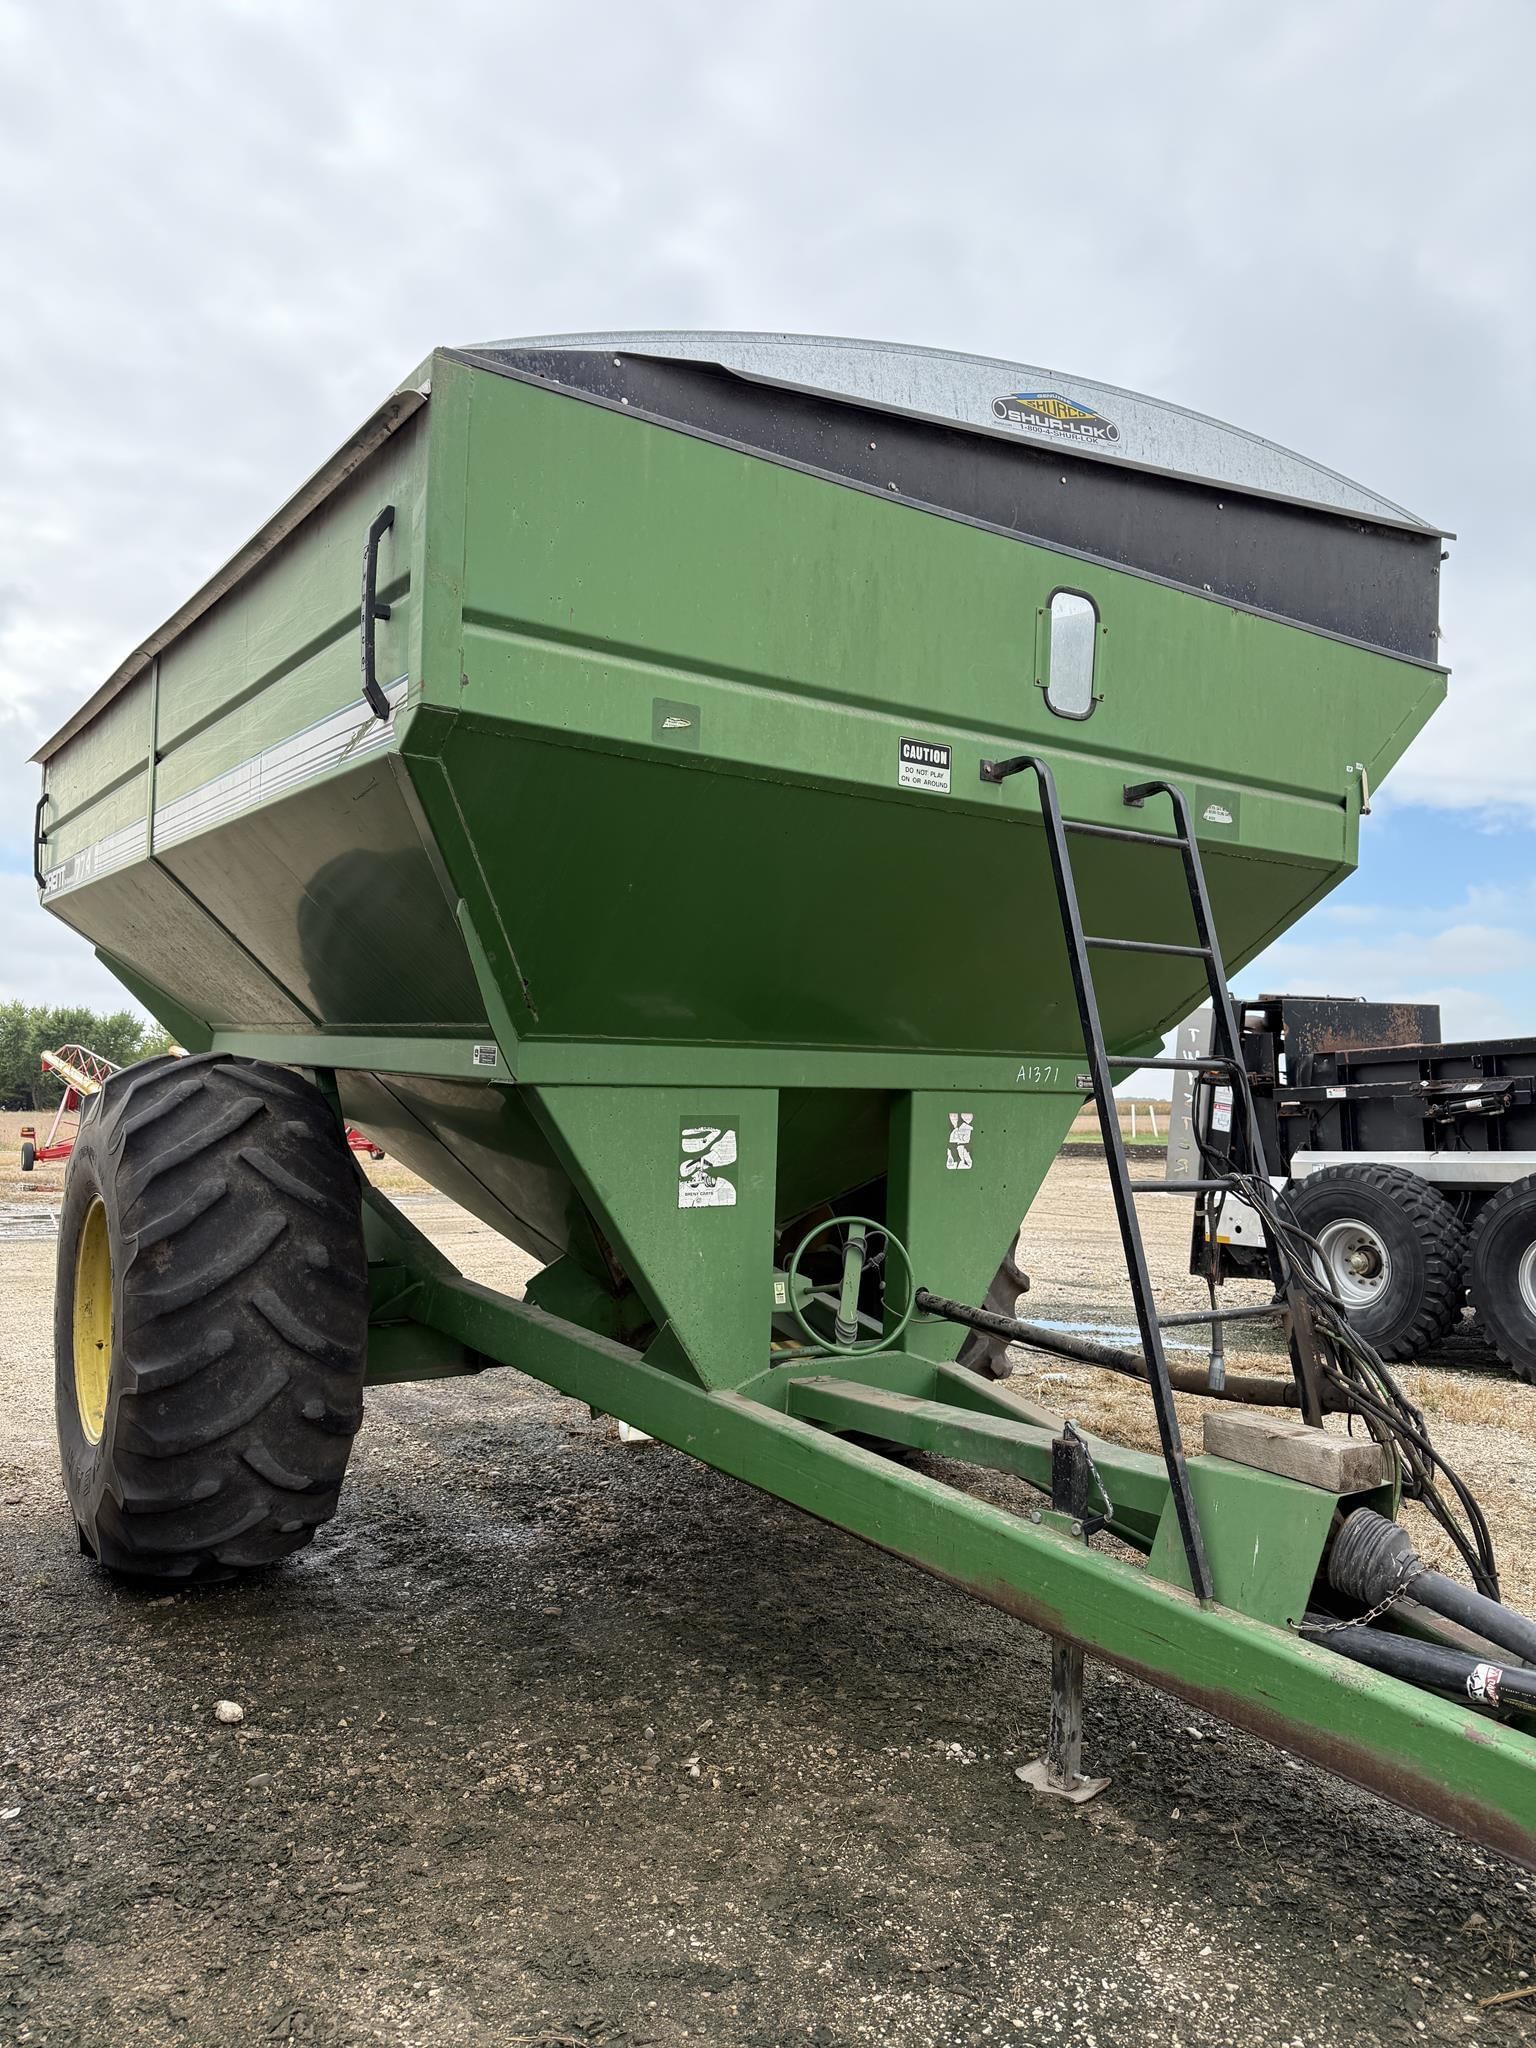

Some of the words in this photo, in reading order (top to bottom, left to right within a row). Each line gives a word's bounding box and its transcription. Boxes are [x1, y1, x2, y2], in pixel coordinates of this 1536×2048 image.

[1007, 410, 1107, 439] SHUR-LOK
[1019, 423, 1099, 444] 1-800-4-SHUR-LOK
[903, 743, 948, 765] CAUTION
[901, 775, 910, 783] ON
[923, 778, 948, 789] AROUND
[905, 766, 914, 774] DO
[916, 768, 928, 776] NOT
[930, 770, 945, 779] PLAY
[1015, 1065, 1060, 1083] A1371
